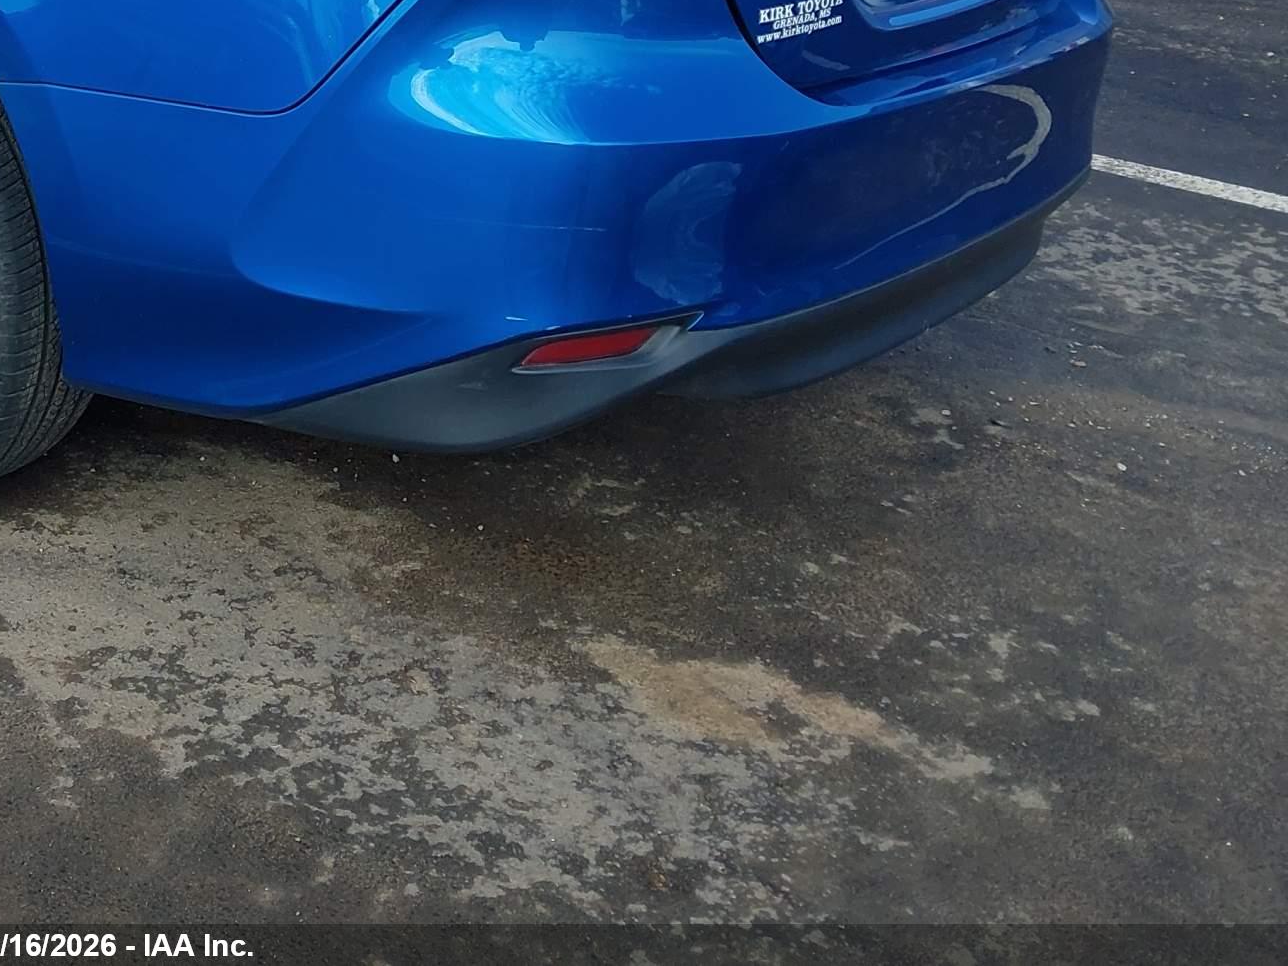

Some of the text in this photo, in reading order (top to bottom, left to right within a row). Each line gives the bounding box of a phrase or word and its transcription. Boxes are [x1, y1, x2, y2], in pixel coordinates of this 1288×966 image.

[759, 4, 794, 24] KIRK
[773, 7, 832, 30] GRENADA, MS
[757, 16, 842, 44] www.kirktoyota.com
